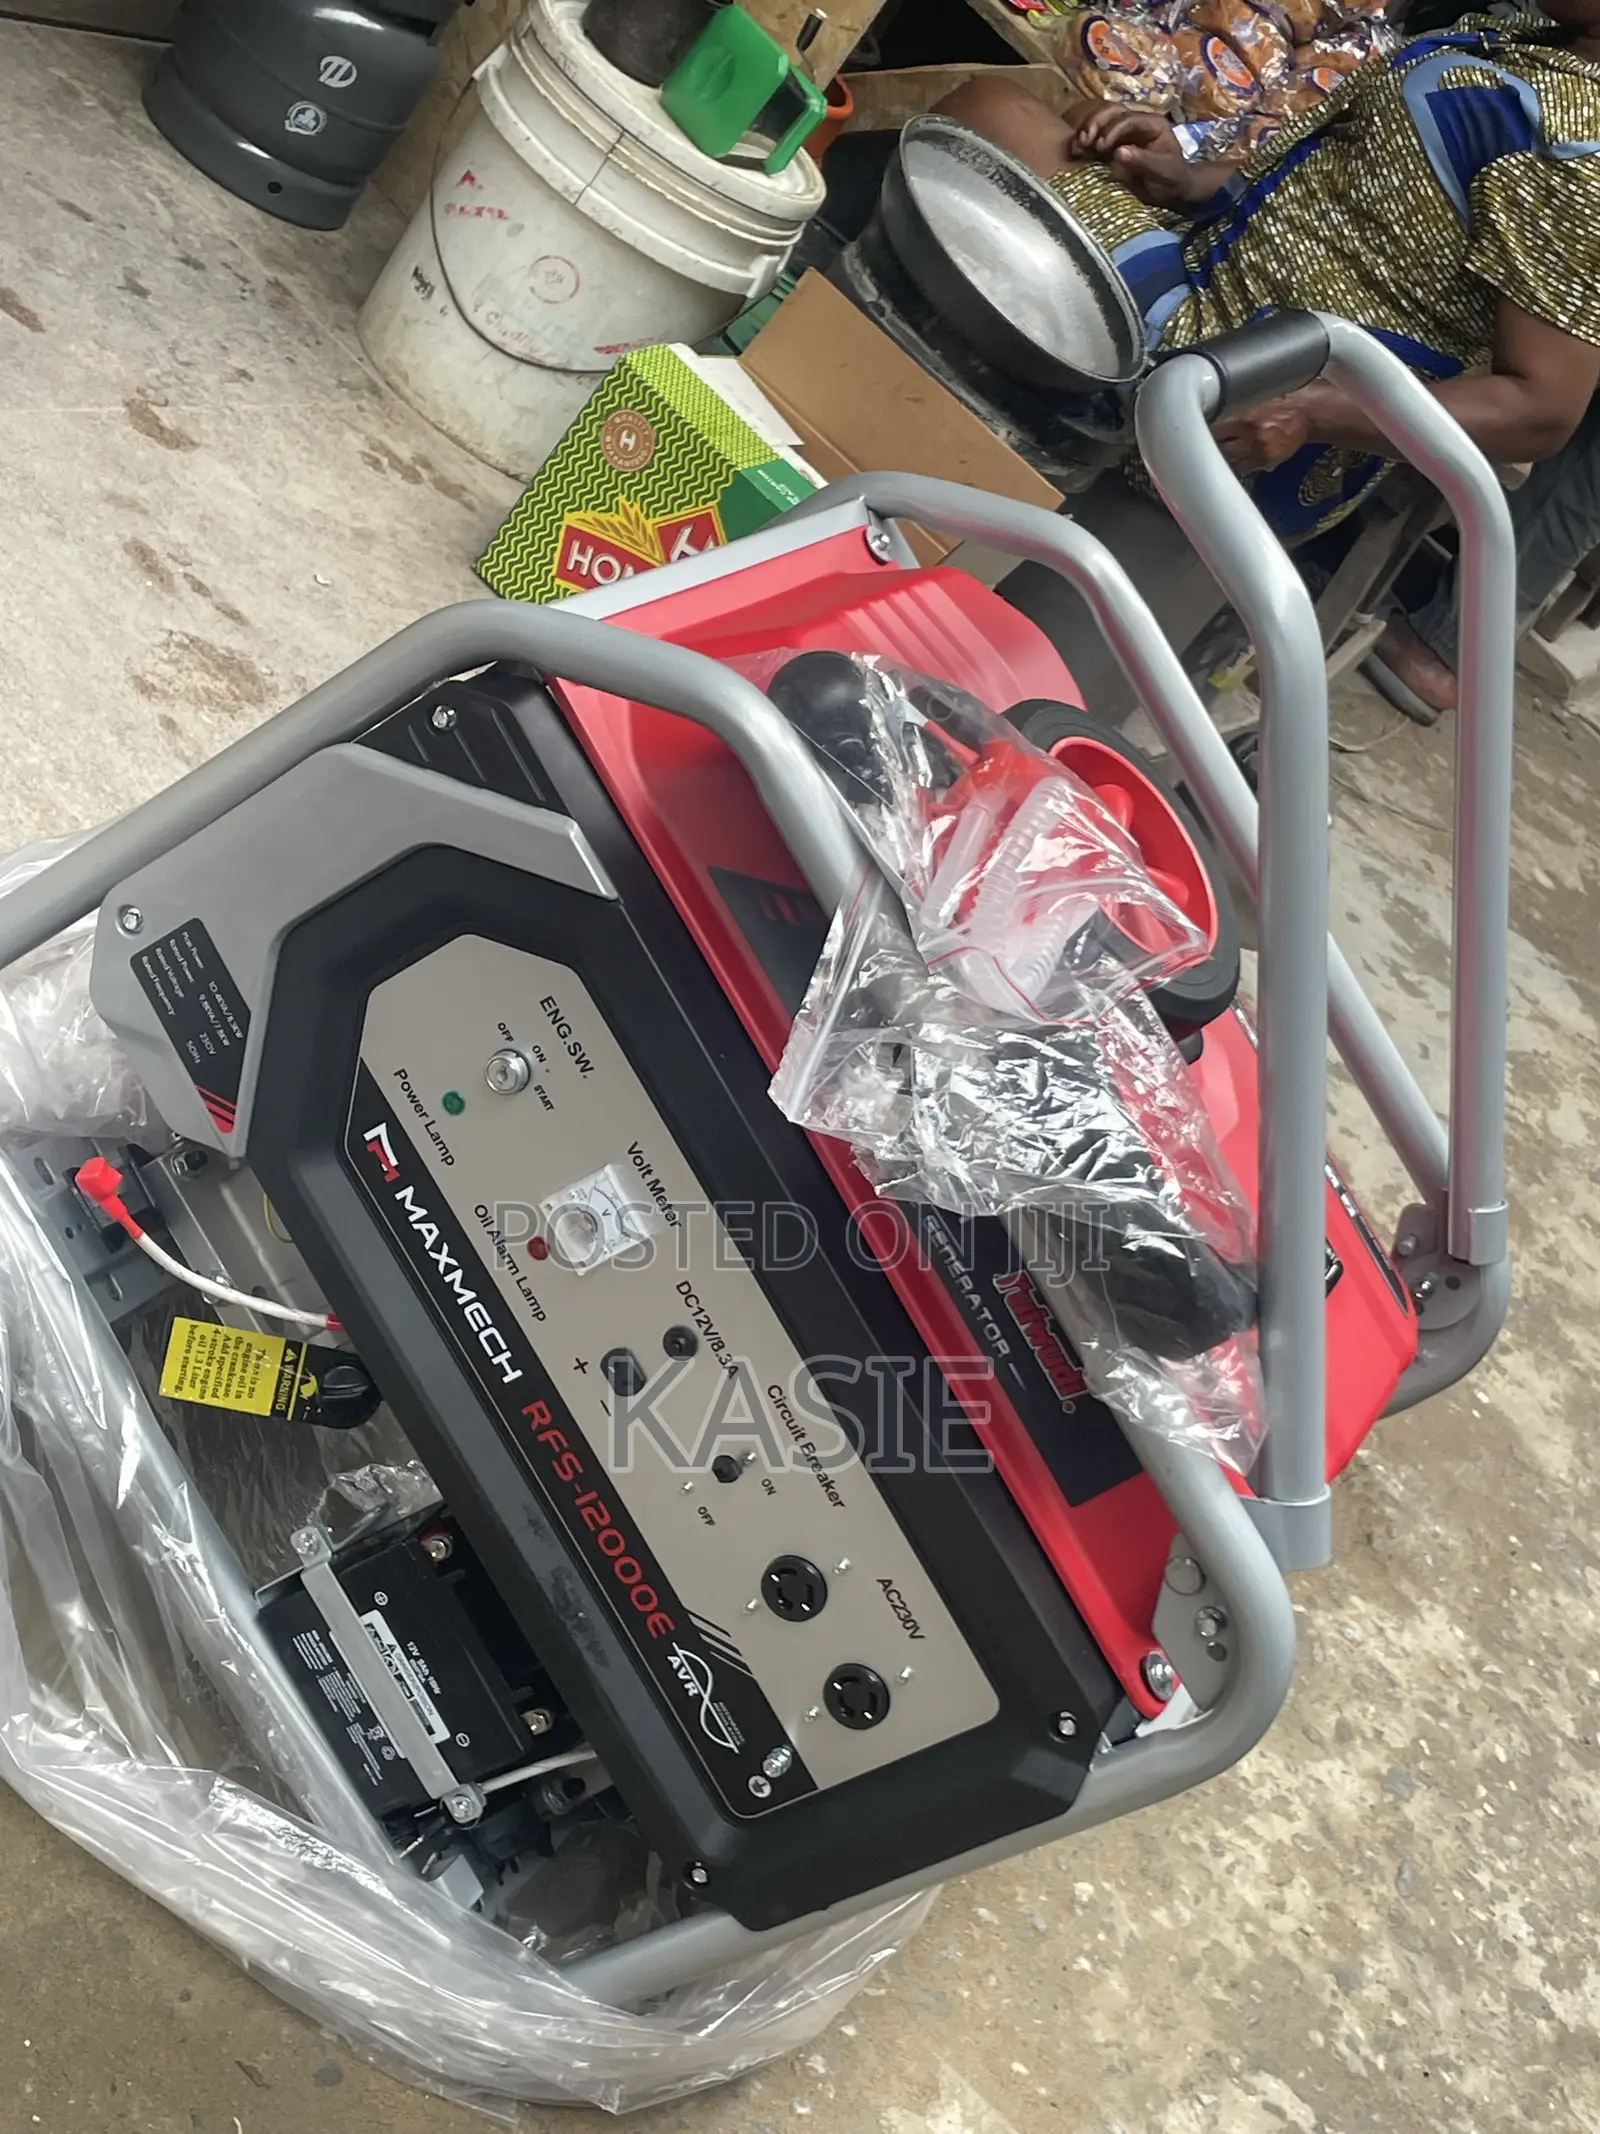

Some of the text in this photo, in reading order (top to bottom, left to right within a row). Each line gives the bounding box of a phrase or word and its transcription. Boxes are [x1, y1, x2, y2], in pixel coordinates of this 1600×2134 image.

[497, 1022, 514, 1043] OFF
[539, 995, 594, 1079] ENG.SW.
[532, 1045, 547, 1063] ON
[533, 1084, 555, 1112] START
[393, 1067, 455, 1167] Power Lamp
[627, 1140, 682, 1229] Volt Meter
[473, 1204, 547, 1323] Oil Alarm Lamp
[185, 1324, 198, 1355] before
[198, 1334, 207, 1349] oil
[234, 1336, 243, 1350] the
[676, 1280, 739, 1380] DC12V/8.3A
[211, 1334, 231, 1399] Add specified
[241, 1342, 253, 1374] engine
[198, 1368, 211, 1400] engine
[237, 1375, 246, 1389] oil
[275, 1363, 294, 1412] WARNING
[394, 1185, 676, 1639] MAXMECH RFS-12000E
[767, 1384, 846, 1509] Circuit Breaker
[761, 1478, 776, 1496] ON
[697, 1506, 716, 1527] OFF
[876, 1578, 926, 1641] AC230V
[666, 1655, 699, 1697] AVR
